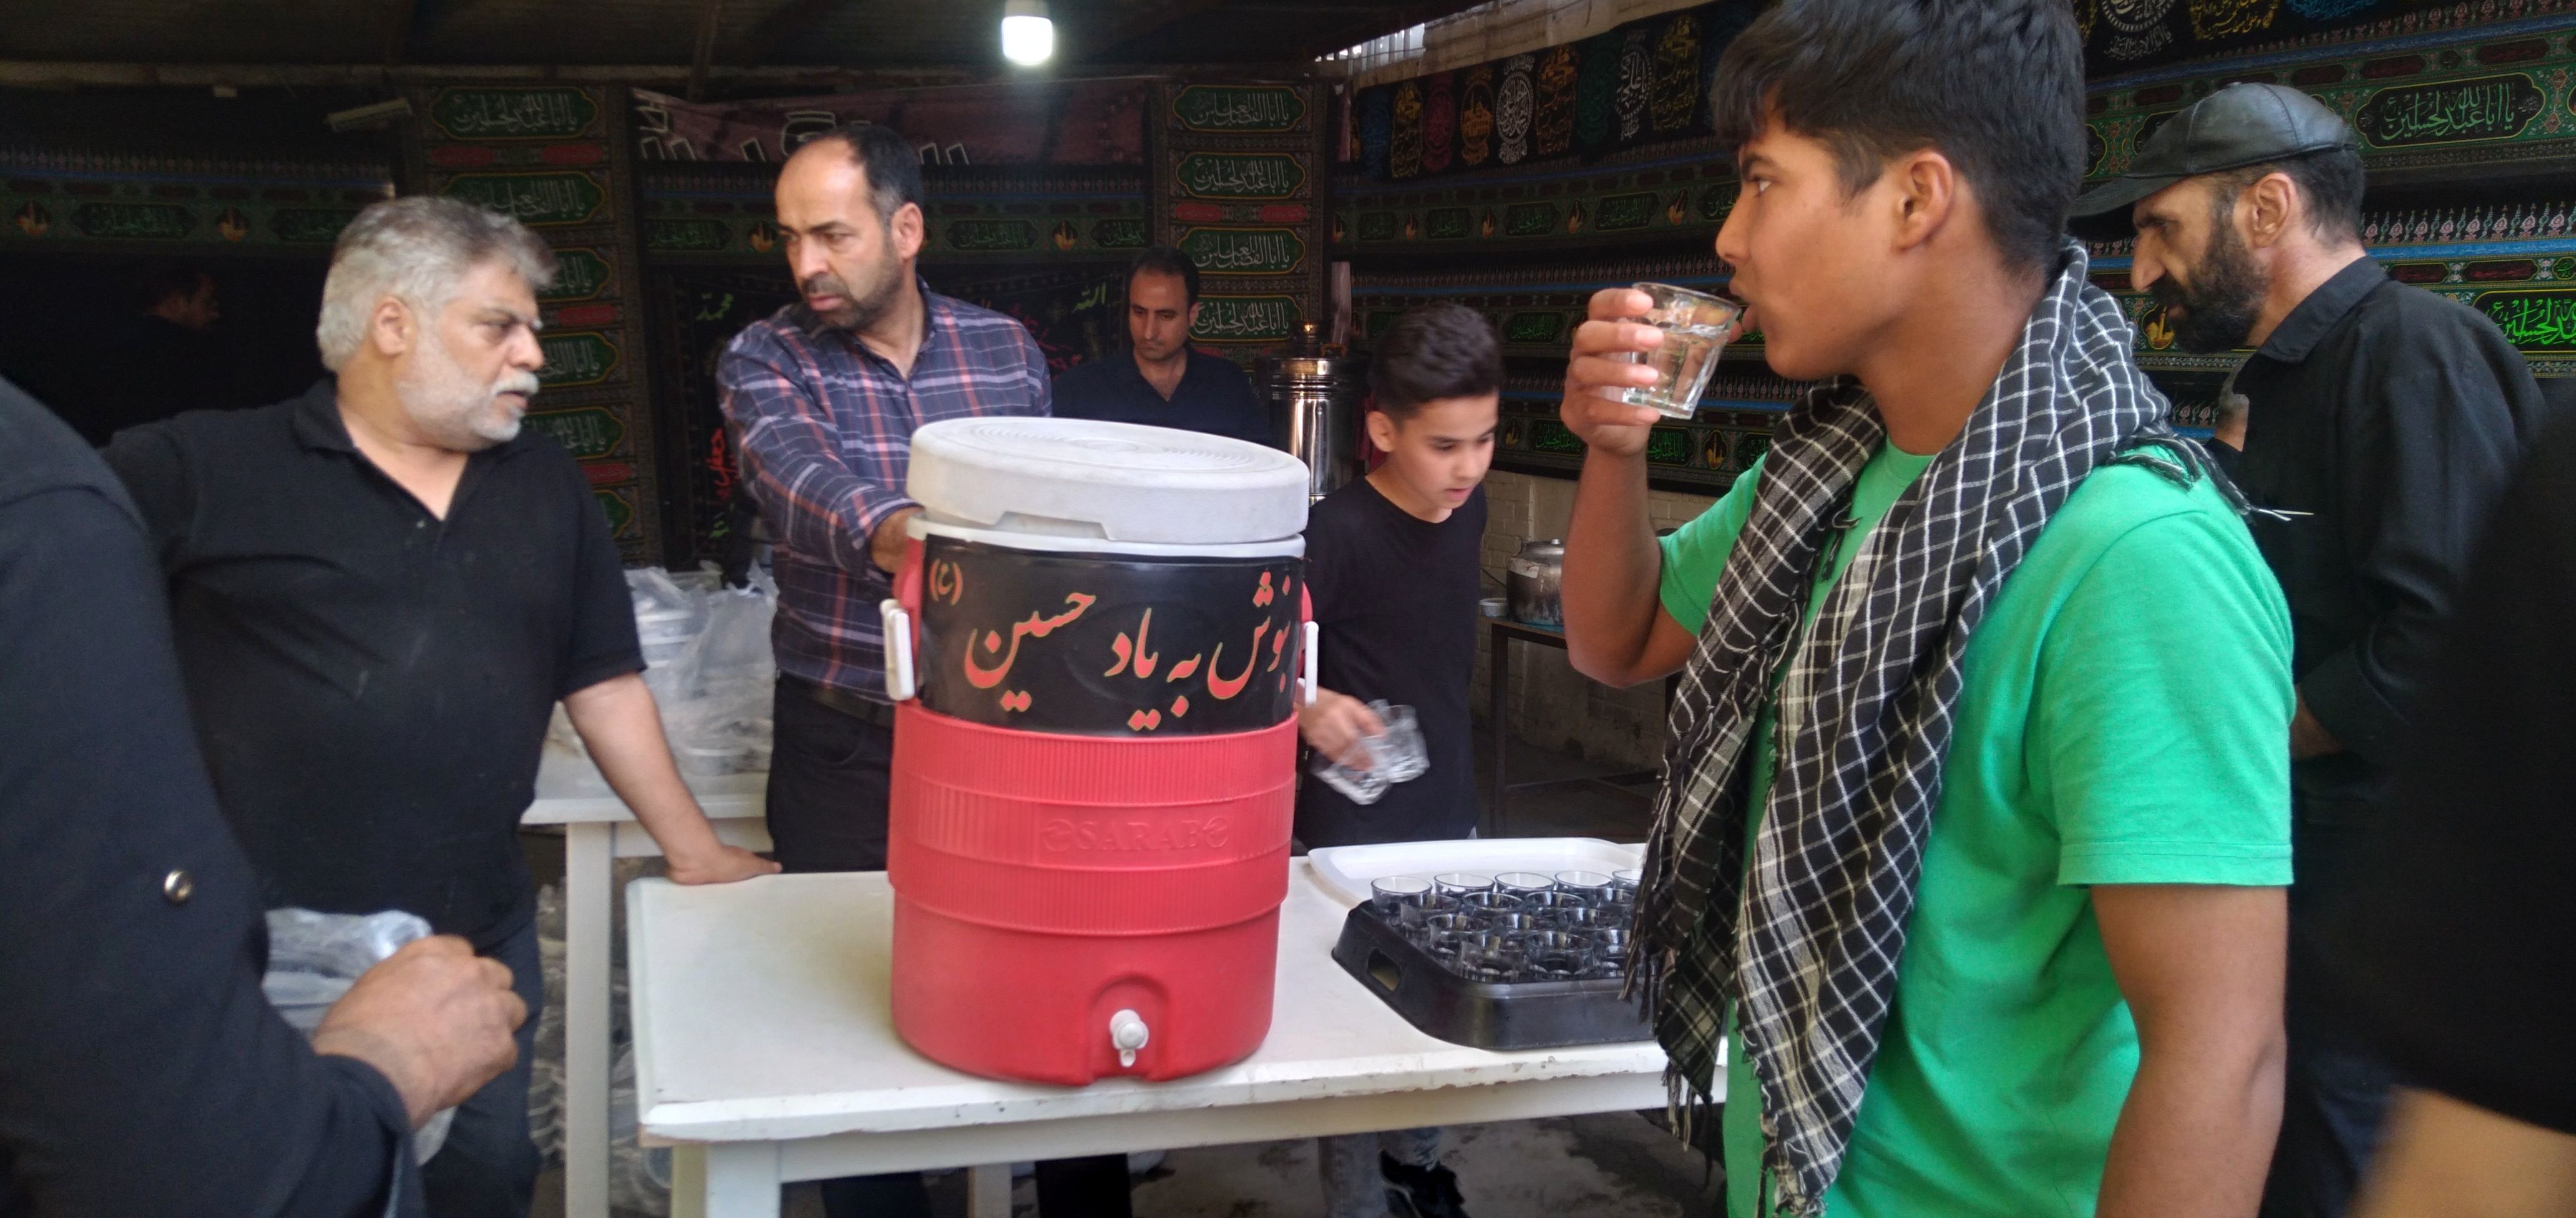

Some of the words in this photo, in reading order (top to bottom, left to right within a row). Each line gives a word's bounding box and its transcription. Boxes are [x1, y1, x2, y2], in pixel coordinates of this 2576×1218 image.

[964, 592, 1096, 712] حسین
[1105, 608, 1161, 731] یاد
[1167, 653, 1201, 718] به
